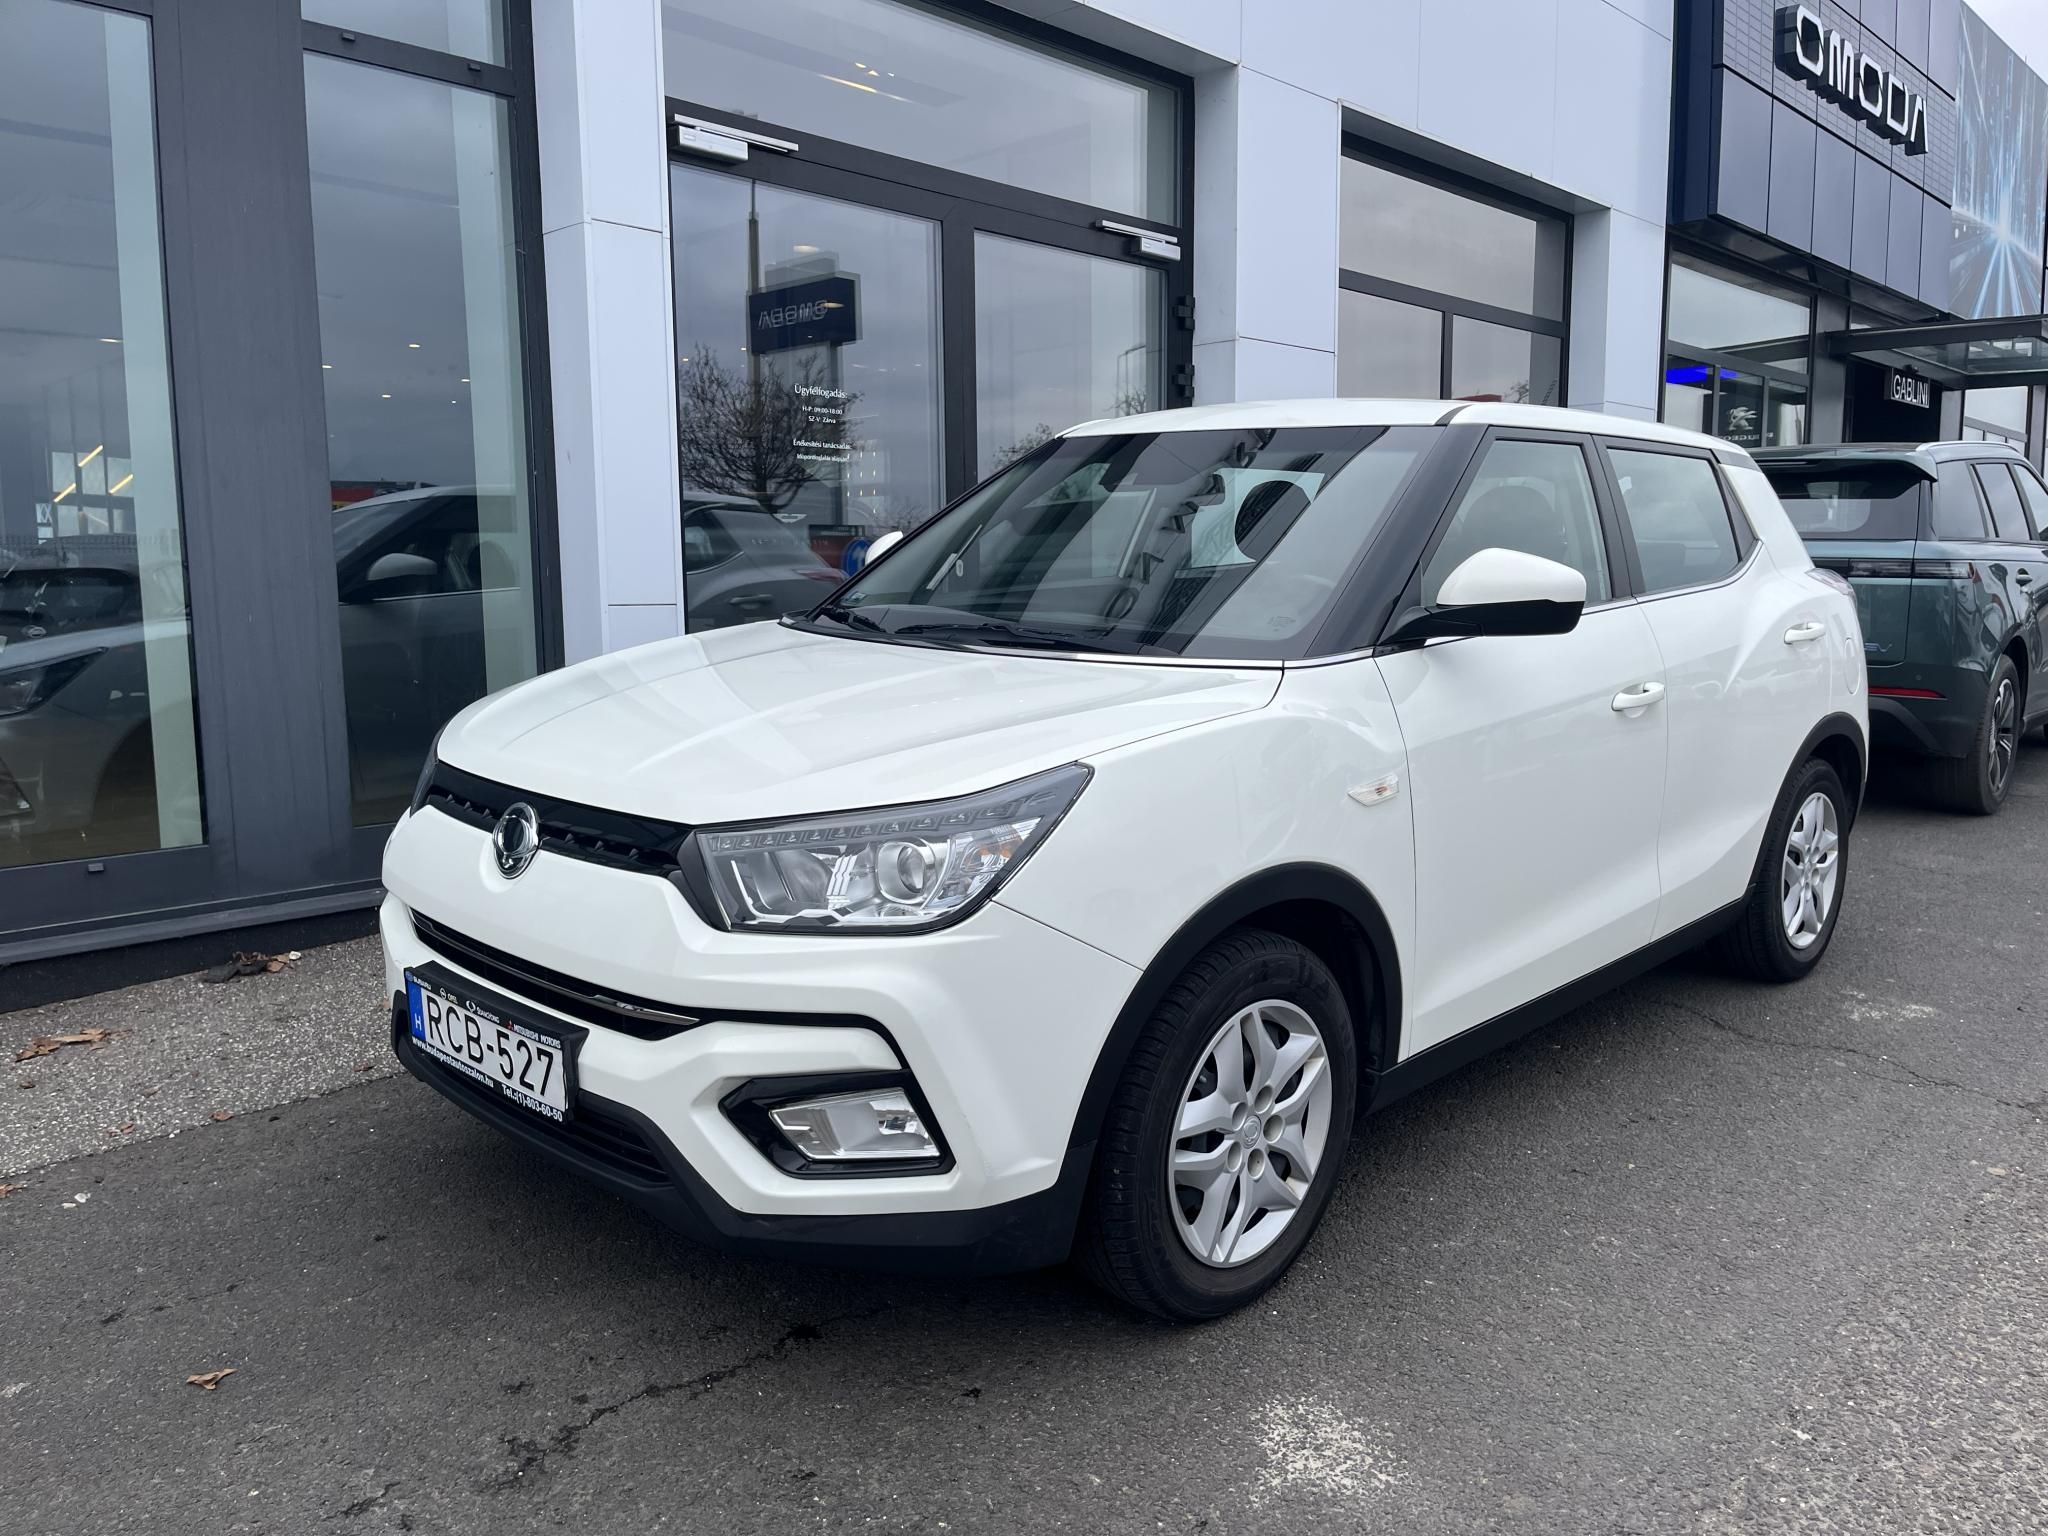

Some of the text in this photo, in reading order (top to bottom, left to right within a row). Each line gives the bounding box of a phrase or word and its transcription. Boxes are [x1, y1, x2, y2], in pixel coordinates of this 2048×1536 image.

[1796, 3, 1929, 155] OMODA
[794, 383, 848, 399] Ügyfélfogadás:
[1893, 374, 1929, 405] GABLINI
[412, 1035, 494, 1088] www.budapestautoszalon.hu
[414, 994, 554, 1097] H RCB-527
[540, 1034, 561, 1049] MOTORS
